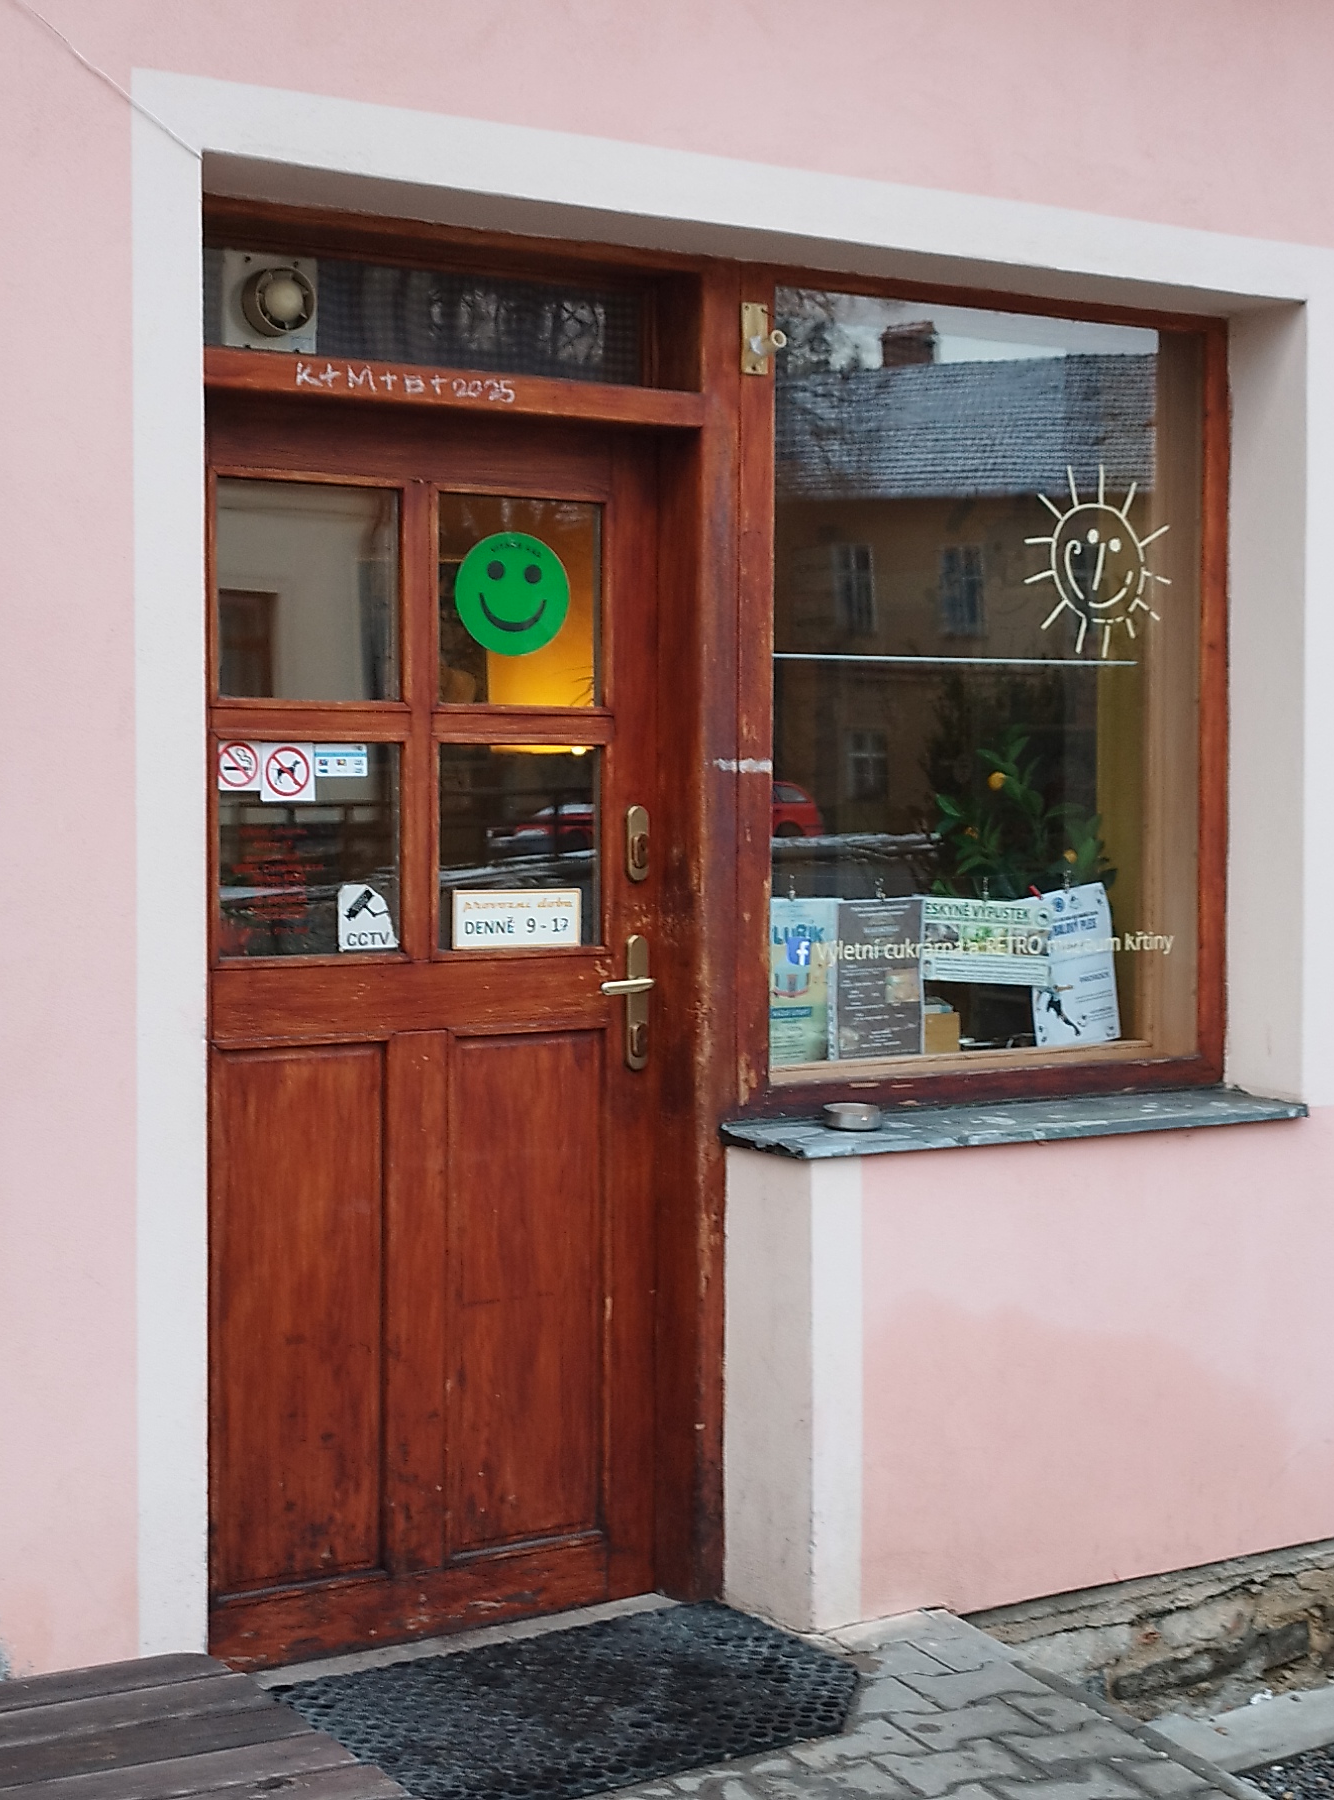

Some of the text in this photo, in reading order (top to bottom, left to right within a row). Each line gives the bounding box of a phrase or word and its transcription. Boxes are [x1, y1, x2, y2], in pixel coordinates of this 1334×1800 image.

[464, 915, 516, 935] DENNĚ
[526, 917, 536, 934] 9
[347, 931, 390, 947] CCTV
